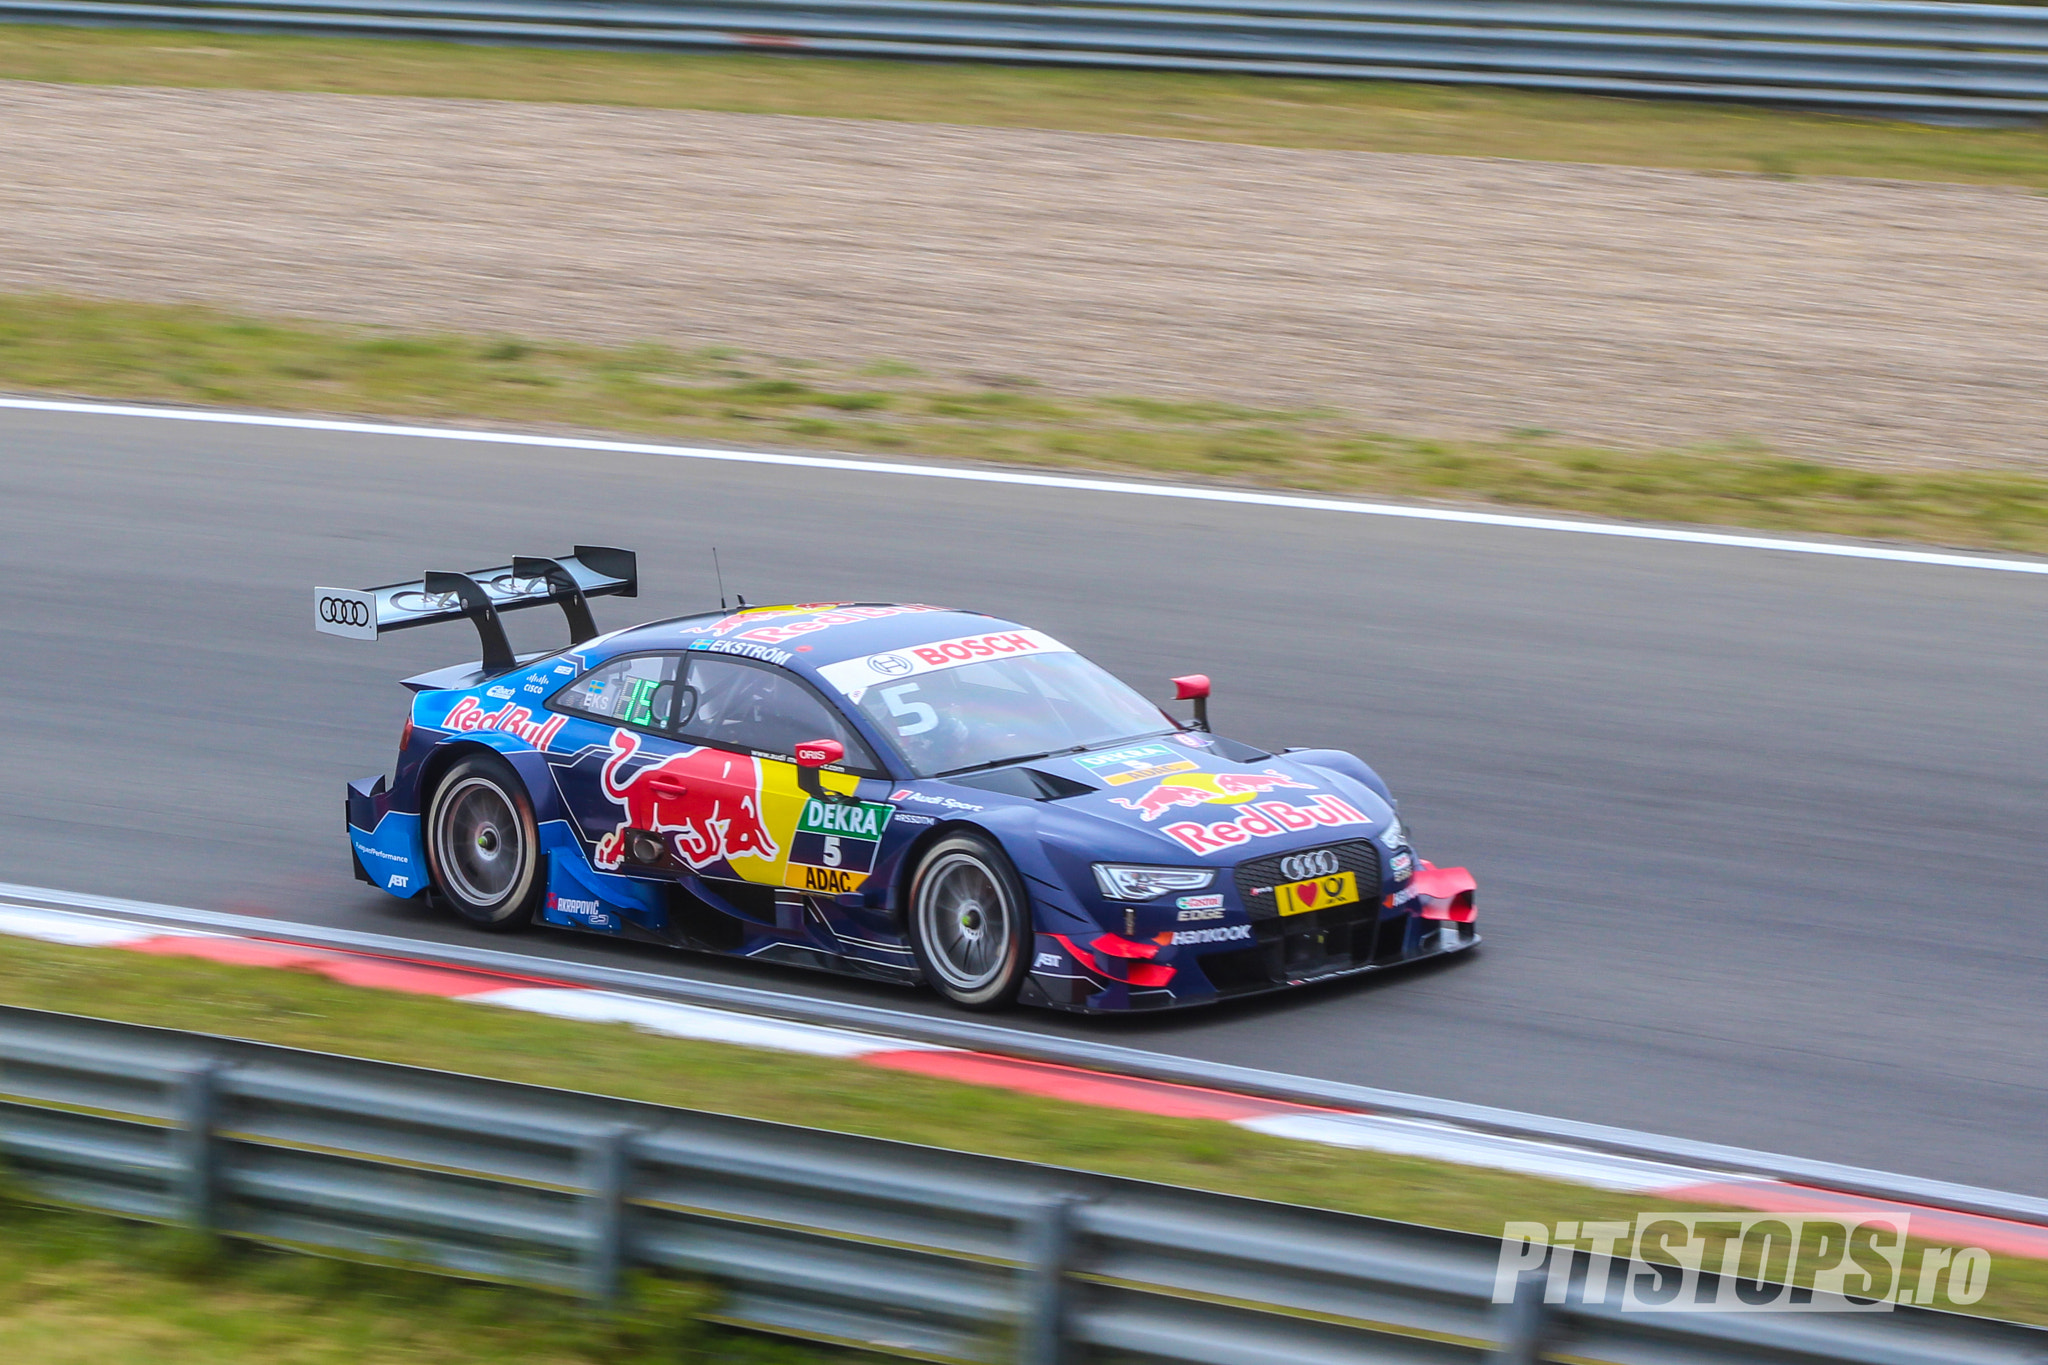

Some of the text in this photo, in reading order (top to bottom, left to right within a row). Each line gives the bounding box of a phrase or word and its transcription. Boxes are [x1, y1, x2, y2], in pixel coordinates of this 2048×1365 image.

[733, 612, 868, 644] Red
[708, 639, 794, 665] EKSTRÖM
[912, 633, 1040, 666] BOSCH
[583, 692, 609, 710] EKS
[879, 682, 939, 737] 5
[441, 696, 570, 752] Red Bull
[799, 749, 826, 760] ORIS
[1082, 746, 1170, 766] DEKRA
[907, 792, 985, 812] Audi Sport
[807, 800, 878, 836] DEKRA
[1158, 794, 1374, 857] Red Bull
[823, 836, 842, 868] 5
[387, 874, 409, 888] ABT
[806, 867, 851, 893] ADAC
[1177, 908, 1226, 921] EDGE
